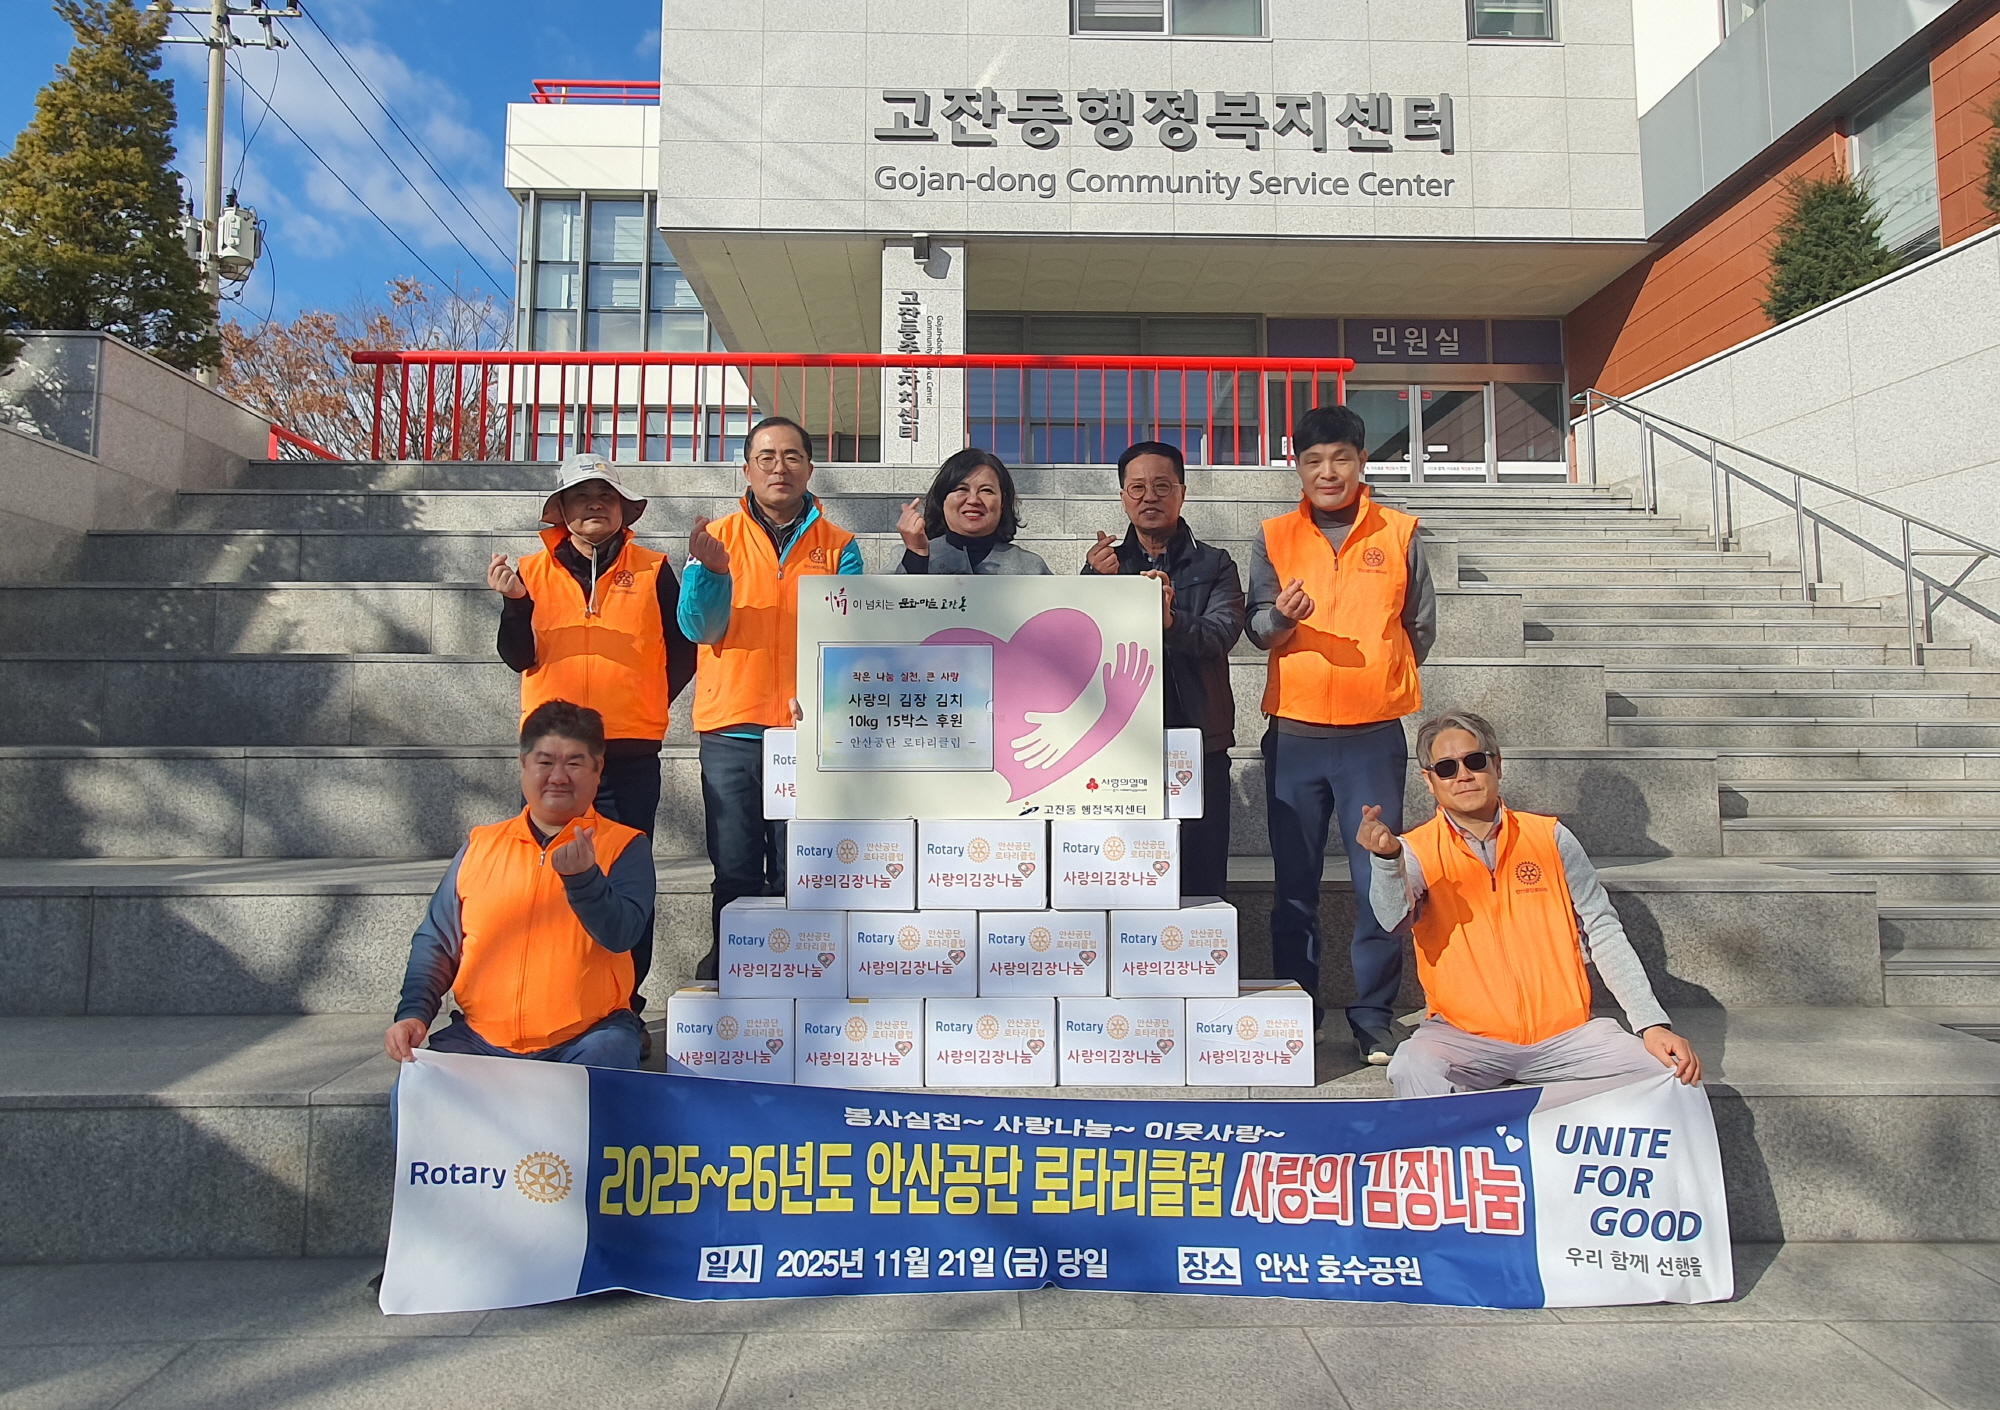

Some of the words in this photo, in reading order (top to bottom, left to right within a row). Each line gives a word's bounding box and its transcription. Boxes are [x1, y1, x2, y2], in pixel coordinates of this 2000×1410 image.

[874, 87, 1455, 154] 고잔동행정복지센터
[874, 165, 1056, 198] Gojan-dong
[1066, 167, 1240, 200] Community
[1249, 169, 1349, 197] Service
[1358, 171, 1455, 197] Center
[1372, 326, 1460, 356] 민원실
[898, 291, 921, 442] 고잔동주자치센터
[865, 599, 895, 610] 넘치는
[852, 672, 871, 682] 작은
[876, 672, 894, 682] 나눔
[900, 672, 920, 682] 실천,
[926, 672, 935, 682] 큰
[940, 672, 960, 682] 사랑
[848, 693, 890, 708] 사랑의
[900, 693, 927, 708] 김장
[936, 693, 963, 708] 김치
[848, 715, 878, 730] 10kg
[886, 714, 928, 728] 15박스
[936, 714, 963, 728] 후원
[850, 737, 896, 748] 안산공단
[903, 737, 960, 748] 로타리클럽
[773, 754, 796, 765] Rota
[1044, 804, 1076, 816] 고잔동
[1082, 804, 1146, 816] 행정복지센터
[866, 843, 899, 851] 안산공단
[928, 844, 964, 857] Rotary
[998, 842, 1030, 850] 안산공단
[1062, 842, 1100, 855] Rotary
[1133, 840, 1165, 849] 안산공단
[796, 845, 832, 858] Rotary
[863, 853, 904, 862] 로타리클럽
[995, 852, 1036, 861] 로타리클럽
[1130, 850, 1171, 860] 로타리클럽
[798, 874, 892, 889] 사랑의김장나눔
[928, 872, 1024, 888] 사랑의김장나눔
[1063, 871, 1158, 886] 사랑의김장나눔
[798, 932, 830, 941] 안산공단
[858, 932, 894, 945] Rotary
[928, 929, 961, 938] 안산공단
[988, 933, 1025, 946] Rotary
[1059, 930, 1092, 939] 안산공단
[1120, 932, 1157, 946] Rotary
[1190, 929, 1222, 938] 안산공단
[728, 934, 765, 948] Rotary
[794, 942, 835, 951] 로타리클럽
[925, 939, 966, 948] 로타리클럽
[1056, 940, 1097, 949] 로타리클럽
[1188, 938, 1228, 948] 로타리클럽
[728, 962, 823, 978] 사랑의김장나눔
[859, 960, 954, 975] 사랑의김장나눔
[990, 962, 1085, 976] 사랑의김장나눔
[1122, 960, 1216, 976] 사랑의김장나눔
[677, 1023, 713, 1035] Rotary
[746, 1019, 779, 1027] 안산공단
[804, 1023, 841, 1036] Rotary
[875, 1021, 908, 1029] 안산공단
[936, 1021, 973, 1034] Rotary
[1007, 1019, 1040, 1027] 안산공단
[1066, 1021, 1103, 1034] Rotary
[1137, 1019, 1169, 1027] 안산공단
[1196, 1022, 1233, 1035] Rotary
[1266, 1019, 1298, 1028] 안산공단
[743, 1028, 784, 1037] 로타리클럽
[872, 1030, 913, 1040] 로타리클럽
[1004, 1028, 1045, 1037] 로타리클럽
[1134, 1028, 1175, 1037] 로타리클럽
[1263, 1029, 1303, 1038] 로타리클럽
[678, 1051, 771, 1065] 사랑의김장나눔
[805, 1052, 901, 1066] 사랑의김장나눔
[937, 1050, 1033, 1064] 사랑의김장나눔
[1068, 1049, 1162, 1064] 사랑의김장나눔
[1199, 1050, 1292, 1065] 사랑의김장나눔
[844, 1107, 984, 1131] 봉사실천~
[994, 1116, 1135, 1138] 사랑나눔~
[1144, 1122, 1286, 1143] 이웃사랑~
[1556, 1124, 1672, 1159] UNITE
[410, 1162, 506, 1190] Rotary
[1574, 1165, 1654, 1199] FOR
[600, 1141, 854, 1216] 2025~26년도
[866, 1141, 1022, 1215] 안산공단
[1032, 1146, 1226, 1218] 로타리클럽
[1231, 1151, 1355, 1226] 사랑의
[1360, 1147, 1526, 1236] 김장나눔
[1590, 1207, 1702, 1242] GOOD
[706, 1248, 758, 1280] 일시
[776, 1247, 864, 1279] 2025년
[874, 1246, 930, 1279] 11월
[938, 1246, 995, 1278] 21일
[1003, 1246, 1049, 1279] (금)
[1056, 1248, 1108, 1279] 당일
[1182, 1250, 1238, 1282] 장소
[1255, 1251, 1309, 1285] 안산
[1317, 1253, 1424, 1287] 호수공원
[1566, 1247, 1603, 1269] 우리
[1609, 1249, 1650, 1275] 함께
[1656, 1256, 1704, 1278] 선행을
